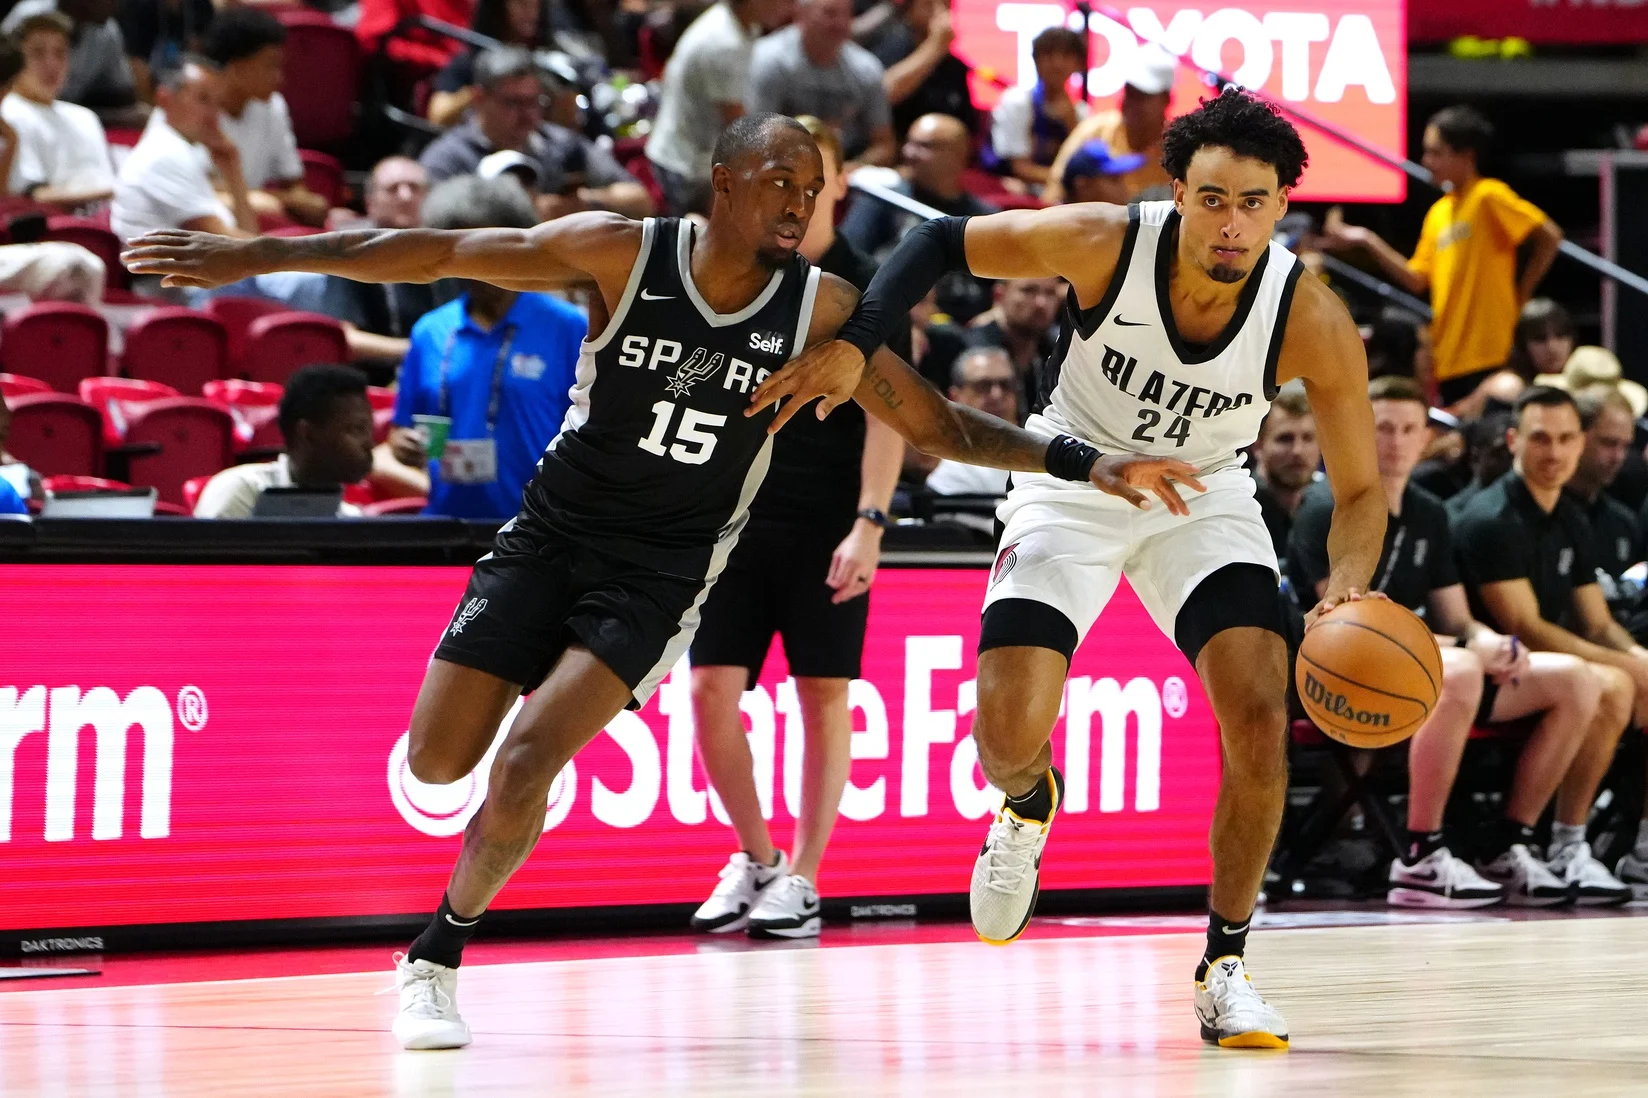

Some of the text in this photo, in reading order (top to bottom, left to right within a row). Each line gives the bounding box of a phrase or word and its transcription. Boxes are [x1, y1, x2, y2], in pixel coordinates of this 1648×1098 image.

[996, 3, 1396, 104] TOYOTA
[638, 400, 728, 465] 15
[1131, 408, 1192, 447] 24
[1305, 671, 1391, 727] Wilson
[21, 936, 104, 953] DAKTRONICS
